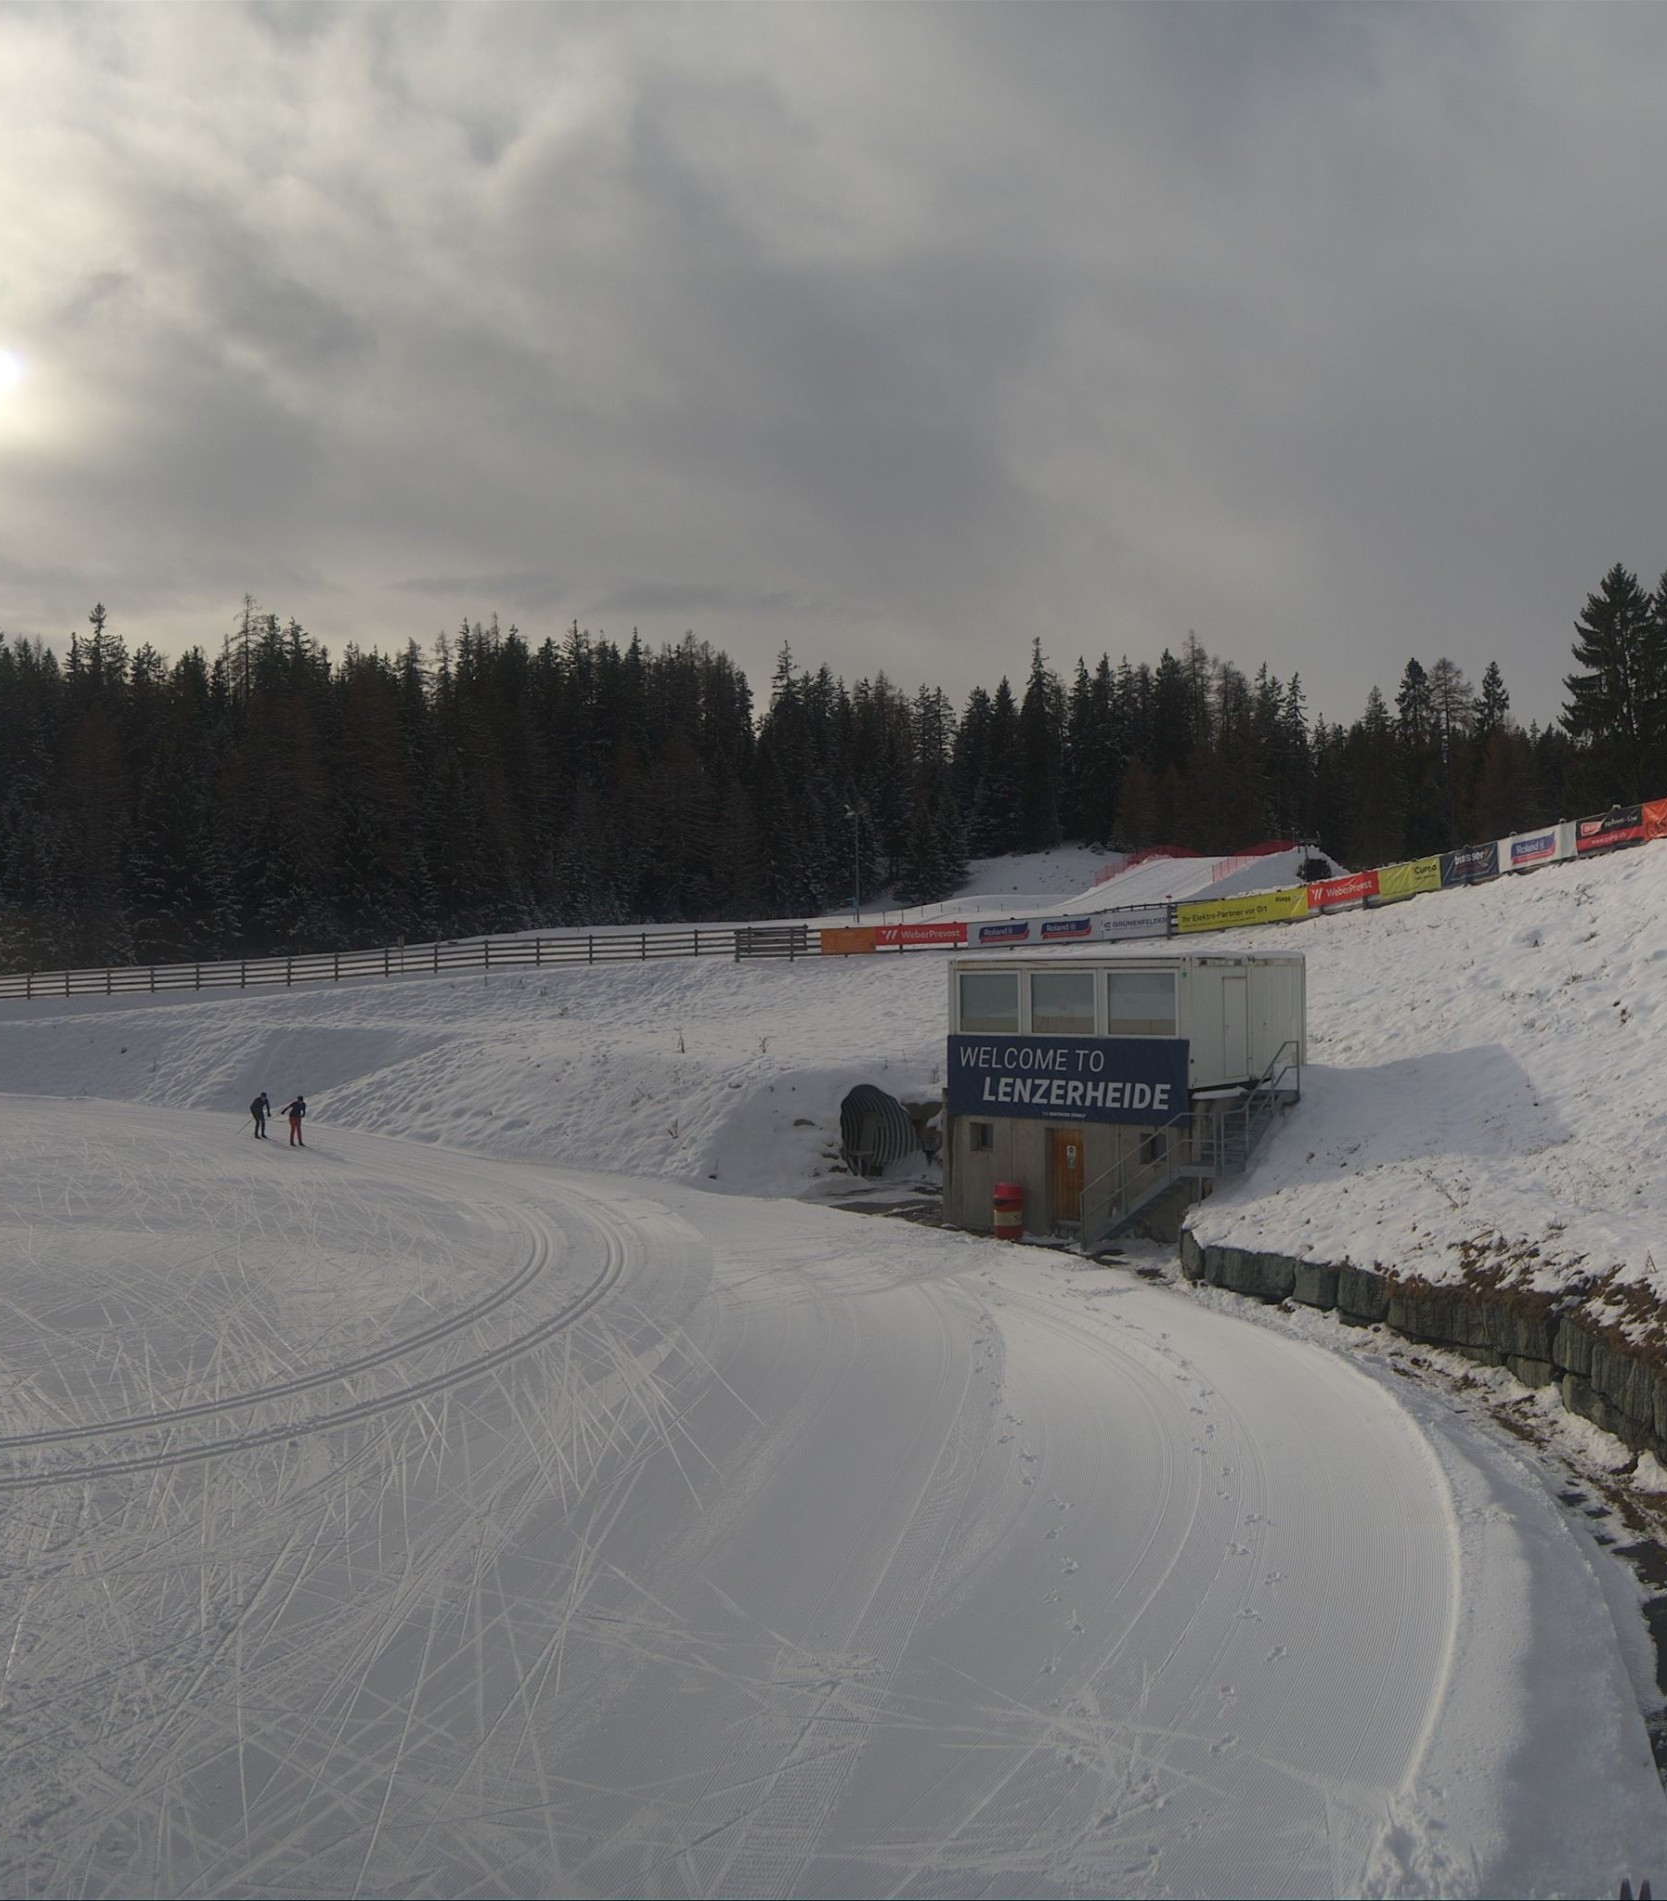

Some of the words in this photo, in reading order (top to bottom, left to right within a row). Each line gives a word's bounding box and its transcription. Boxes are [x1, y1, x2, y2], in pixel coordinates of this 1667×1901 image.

[1516, 841, 1539, 853] Roland
[901, 928, 961, 940] WeberPrevost
[984, 928, 1007, 937] Roland
[1046, 924, 1069, 933] Roland
[959, 1046, 1068, 1072] WELCOME
[1075, 1049, 1105, 1073] TO
[982, 1076, 1172, 1110] LENZERHEIDE
